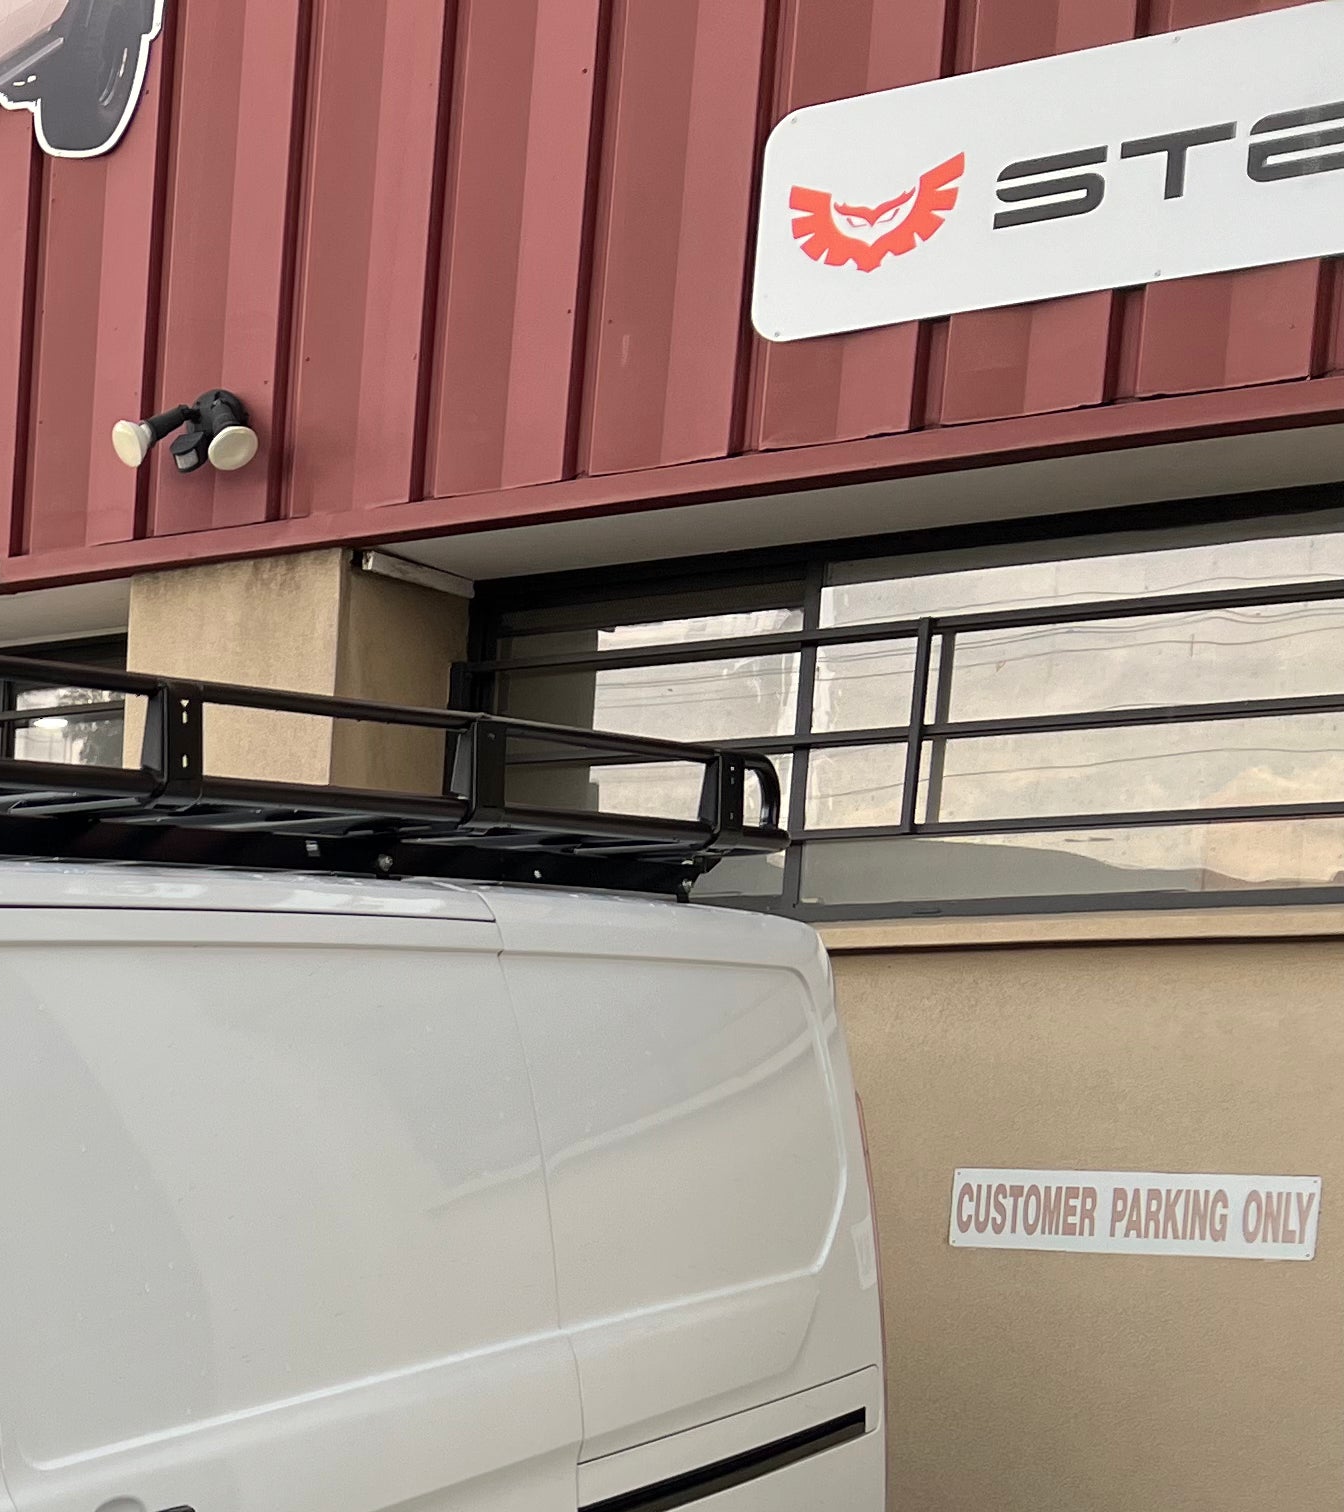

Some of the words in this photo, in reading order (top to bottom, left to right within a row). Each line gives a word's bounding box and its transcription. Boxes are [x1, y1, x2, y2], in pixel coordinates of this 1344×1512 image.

[956, 1182, 1097, 1237] CUSTOMER
[1109, 1187, 1229, 1242] PARKING
[1242, 1189, 1316, 1244] ONLY
